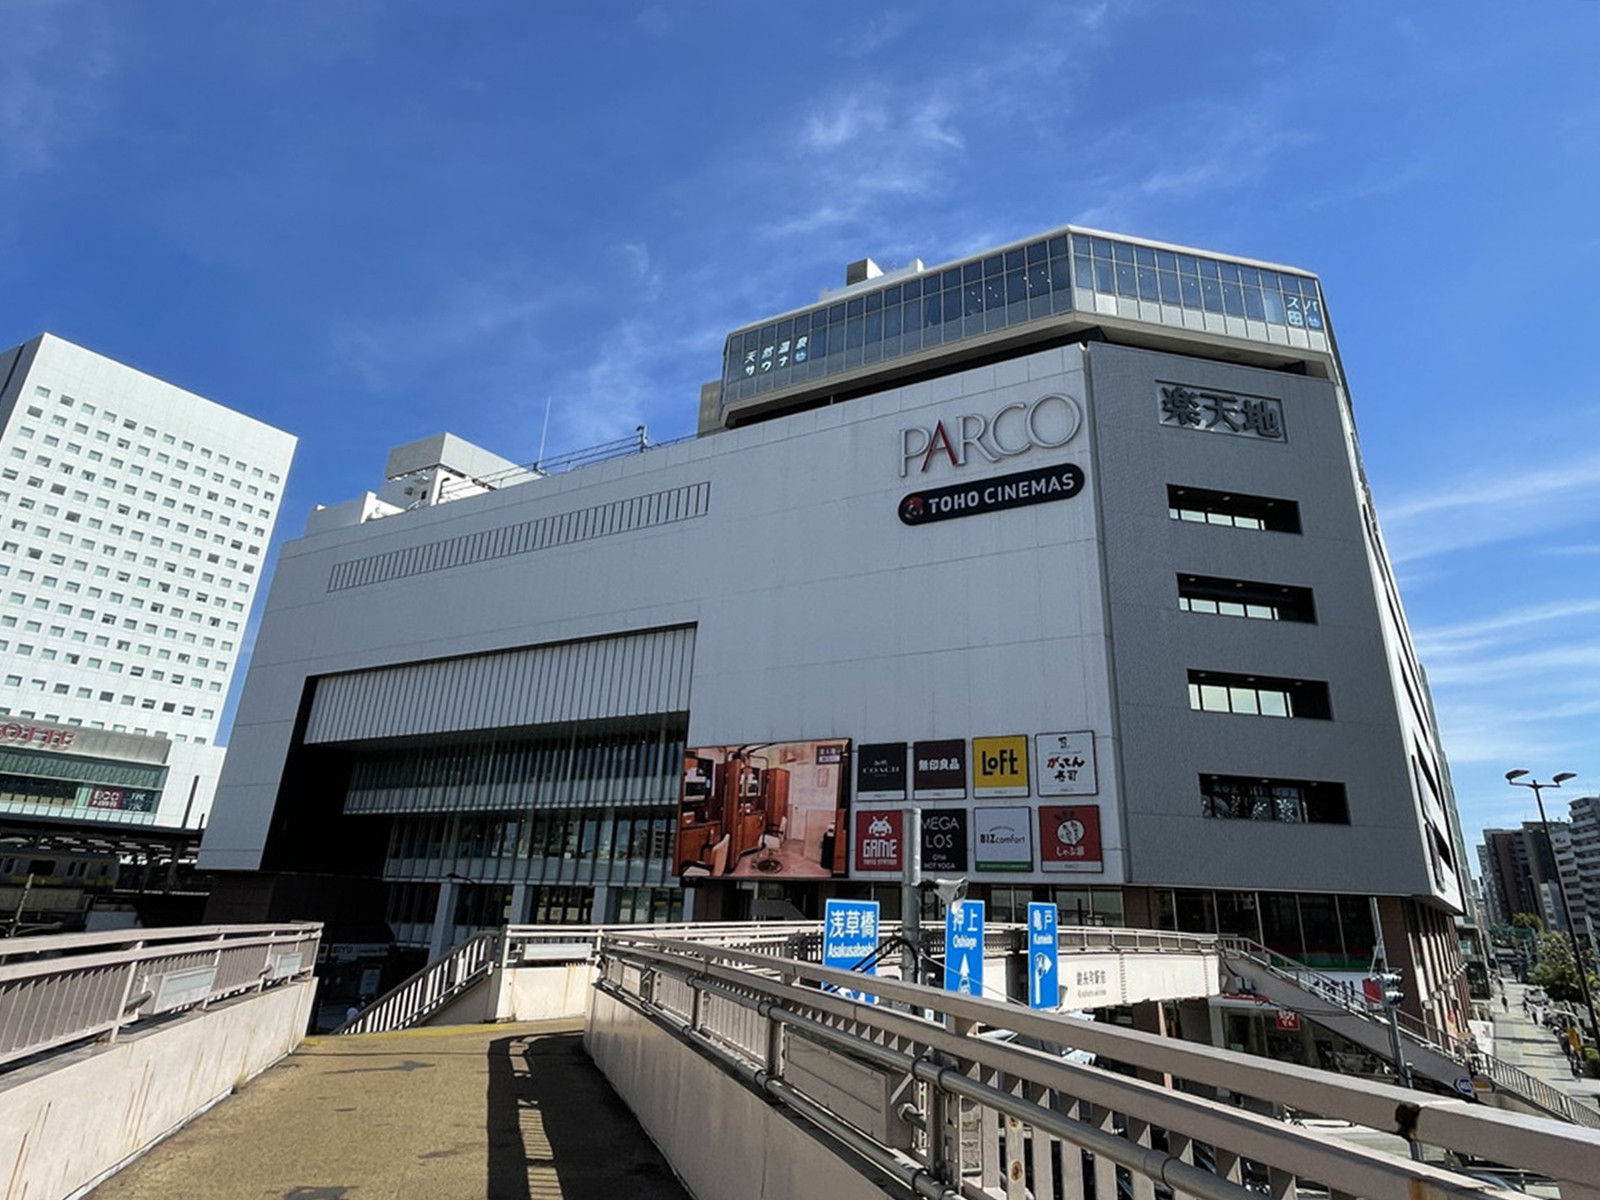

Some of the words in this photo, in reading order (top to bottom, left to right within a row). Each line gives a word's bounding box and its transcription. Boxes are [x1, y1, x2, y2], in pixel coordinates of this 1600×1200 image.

[744, 336, 808, 364] 天然温泉
[745, 356, 788, 376] サウナ
[1161, 386, 1282, 438] 楽天地
[899, 392, 1081, 479] PARCO
[928, 490, 979, 514] TOHO
[984, 473, 1075, 505] CINEMAS
[918, 757, 960, 771] 無印良品
[1046, 756, 1085, 769] がってん
[1054, 770, 1078, 782] 寿司
[921, 816, 960, 830] MEGA
[863, 839, 897, 858] GAME
[925, 834, 953, 849] LOS
[828, 909, 875, 938] 浅草橋
[953, 908, 978, 932] 押上
[1033, 909, 1053, 931] 亀戸
